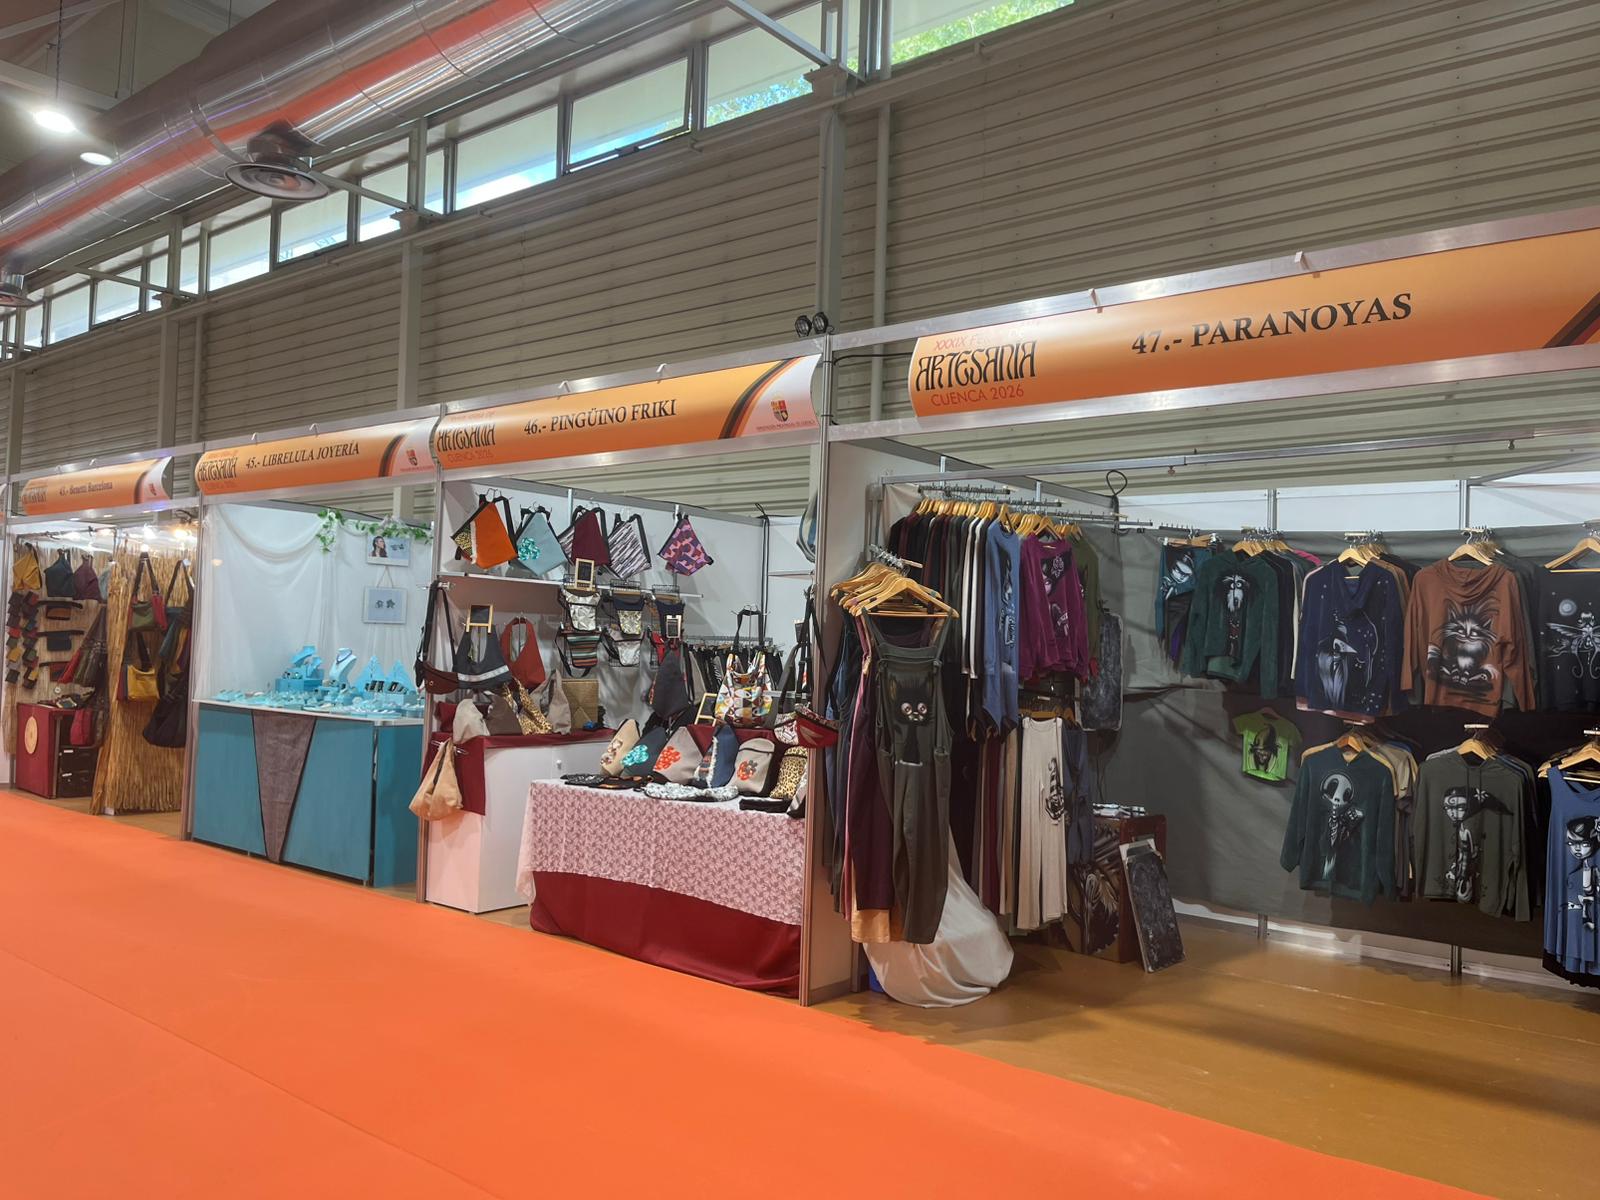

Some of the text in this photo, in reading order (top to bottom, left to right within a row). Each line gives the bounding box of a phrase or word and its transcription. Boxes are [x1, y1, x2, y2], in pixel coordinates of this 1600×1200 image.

[1131, 292, 1412, 355] 47.- PARANOYAS
[915, 340, 1037, 392] ARTESANIA
[523, 399, 677, 436] 46.- PINGÜINO FRIKI
[930, 384, 1025, 407] CUENCA 2026
